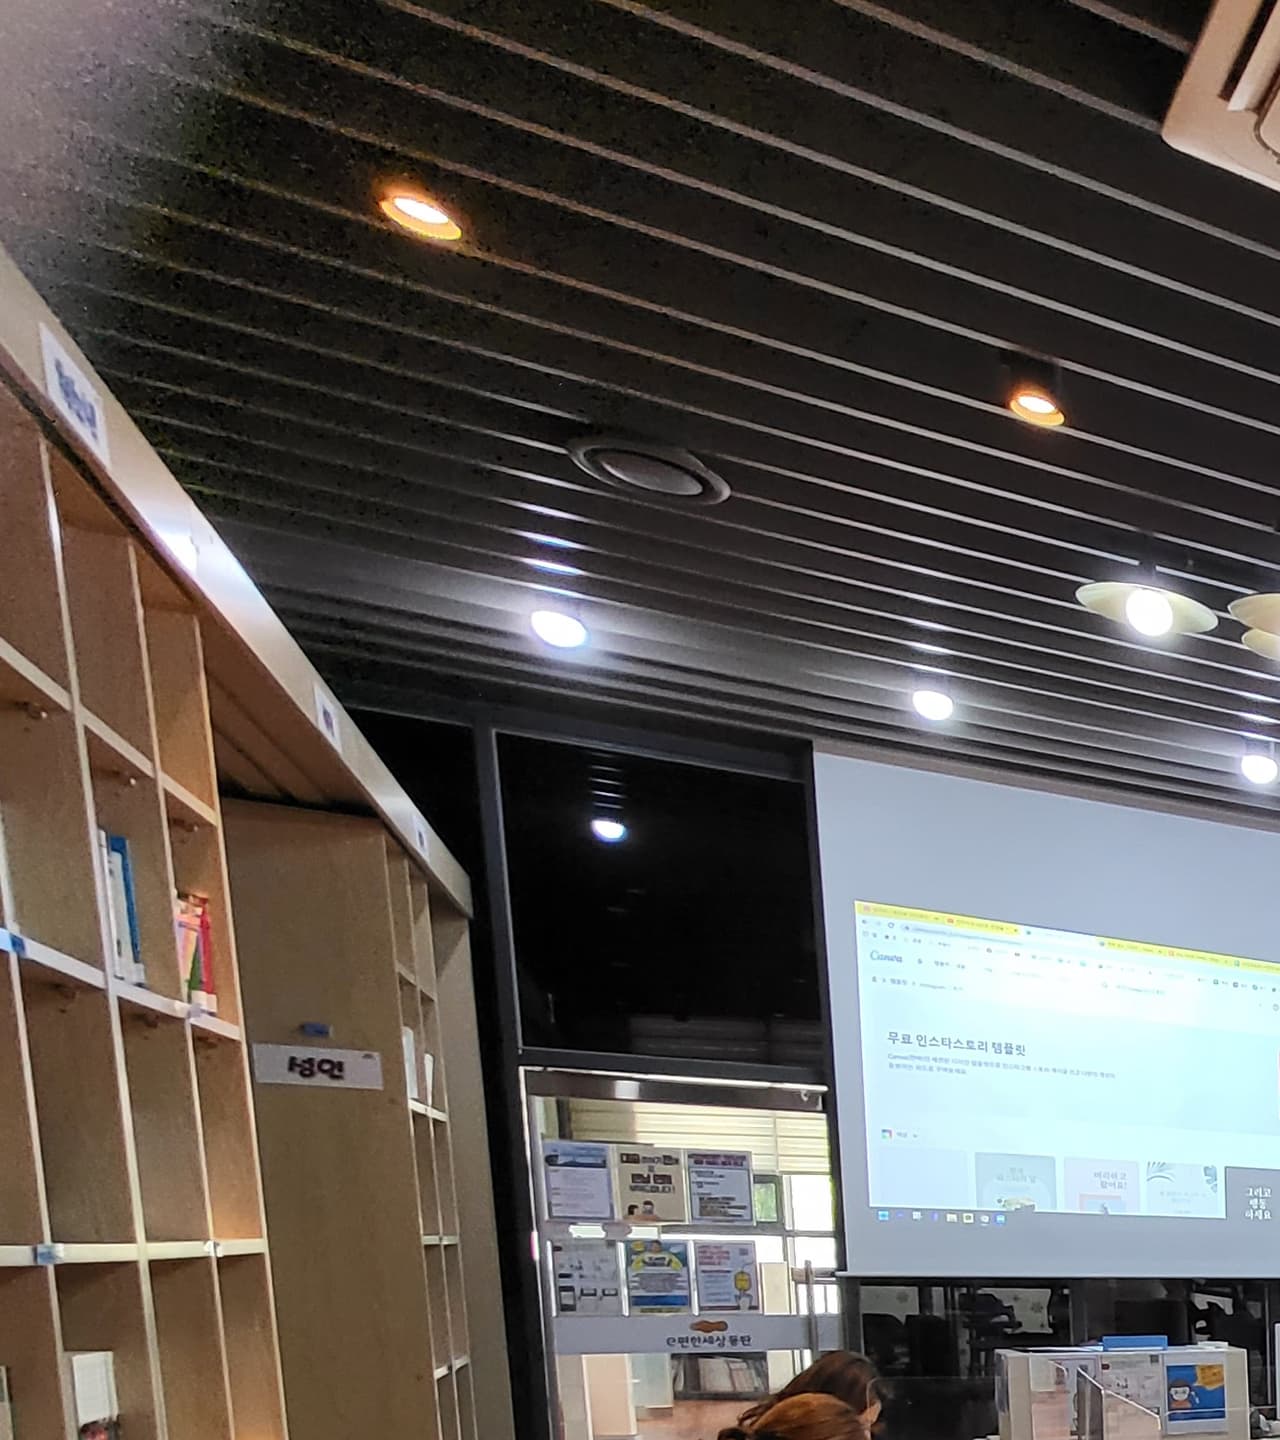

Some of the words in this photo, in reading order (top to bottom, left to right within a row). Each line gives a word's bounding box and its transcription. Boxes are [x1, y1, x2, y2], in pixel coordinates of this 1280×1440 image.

[887, 1030, 913, 1046] 무료
[915, 1032, 988, 1055] 인스타스토리
[991, 1042, 1026, 1057] 템플릿
